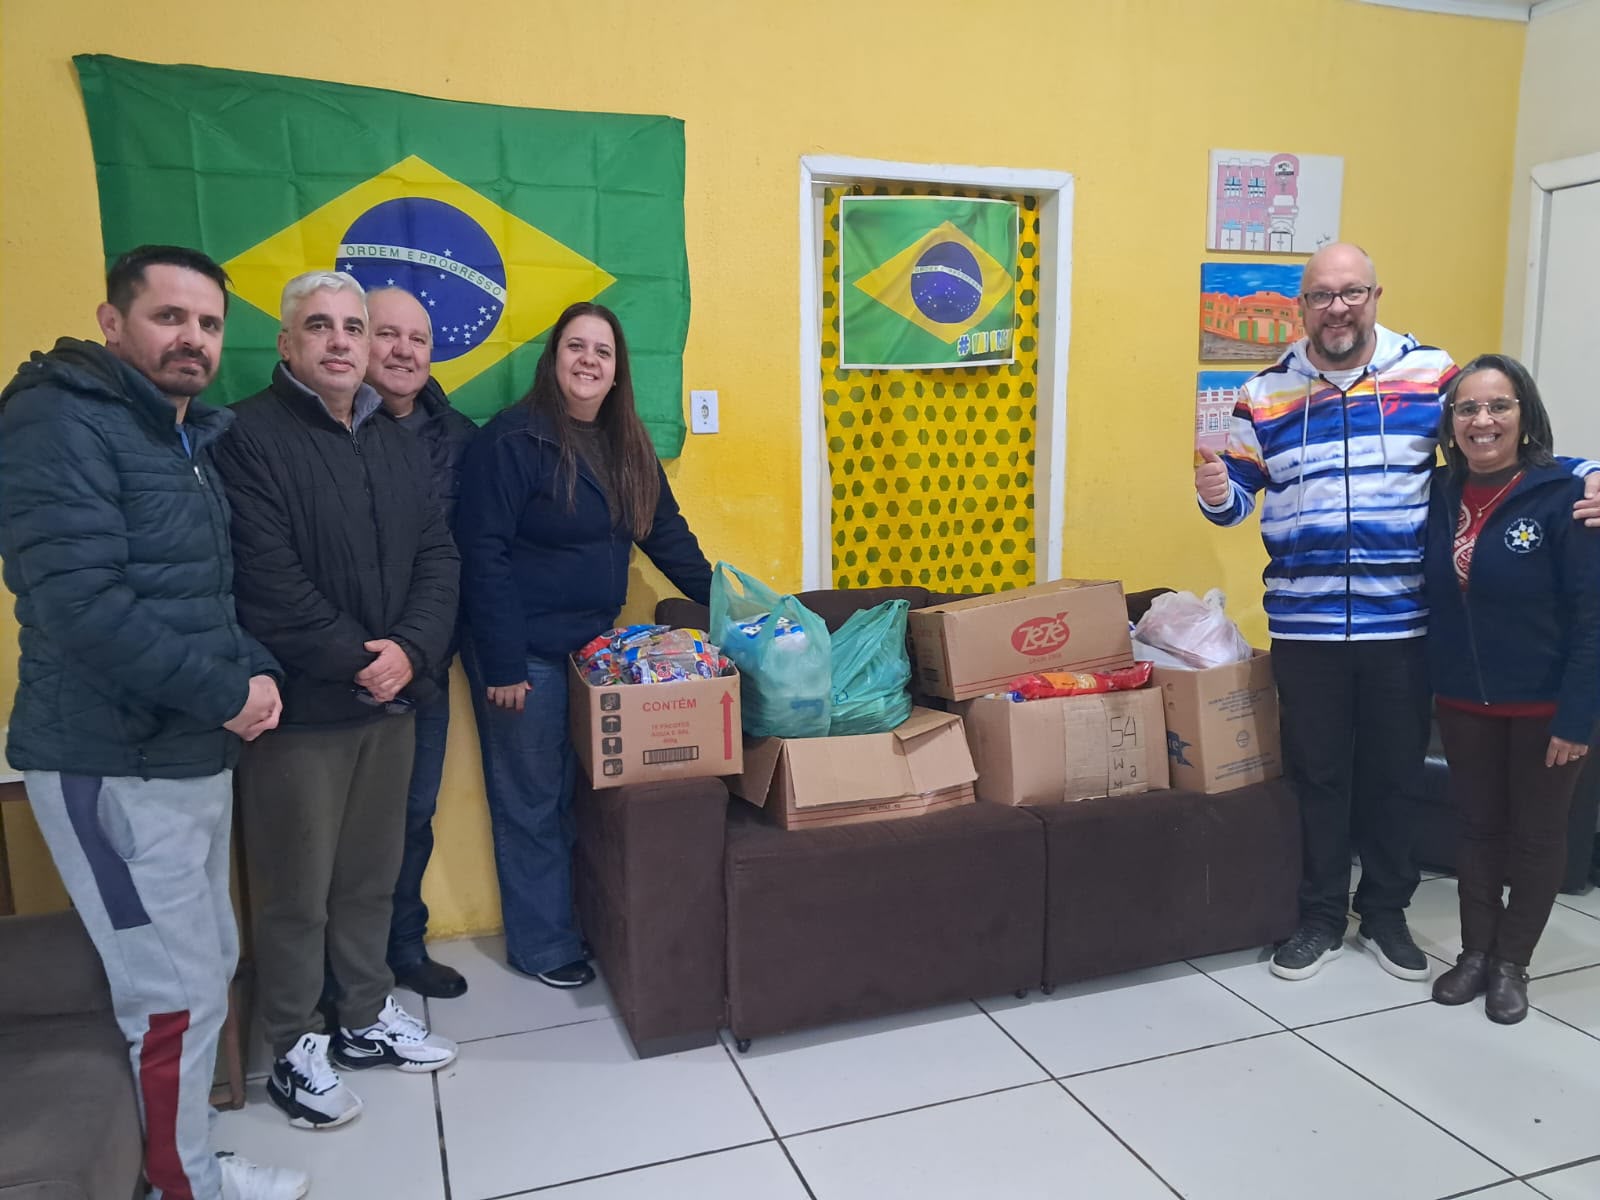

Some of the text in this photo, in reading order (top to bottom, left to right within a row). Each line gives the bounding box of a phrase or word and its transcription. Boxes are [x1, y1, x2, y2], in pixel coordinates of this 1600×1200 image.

[346, 245, 502, 296] ORDEM E PROGRESSO
[642, 697, 697, 712] CONTÉM
[1110, 716, 1136, 748] 54
